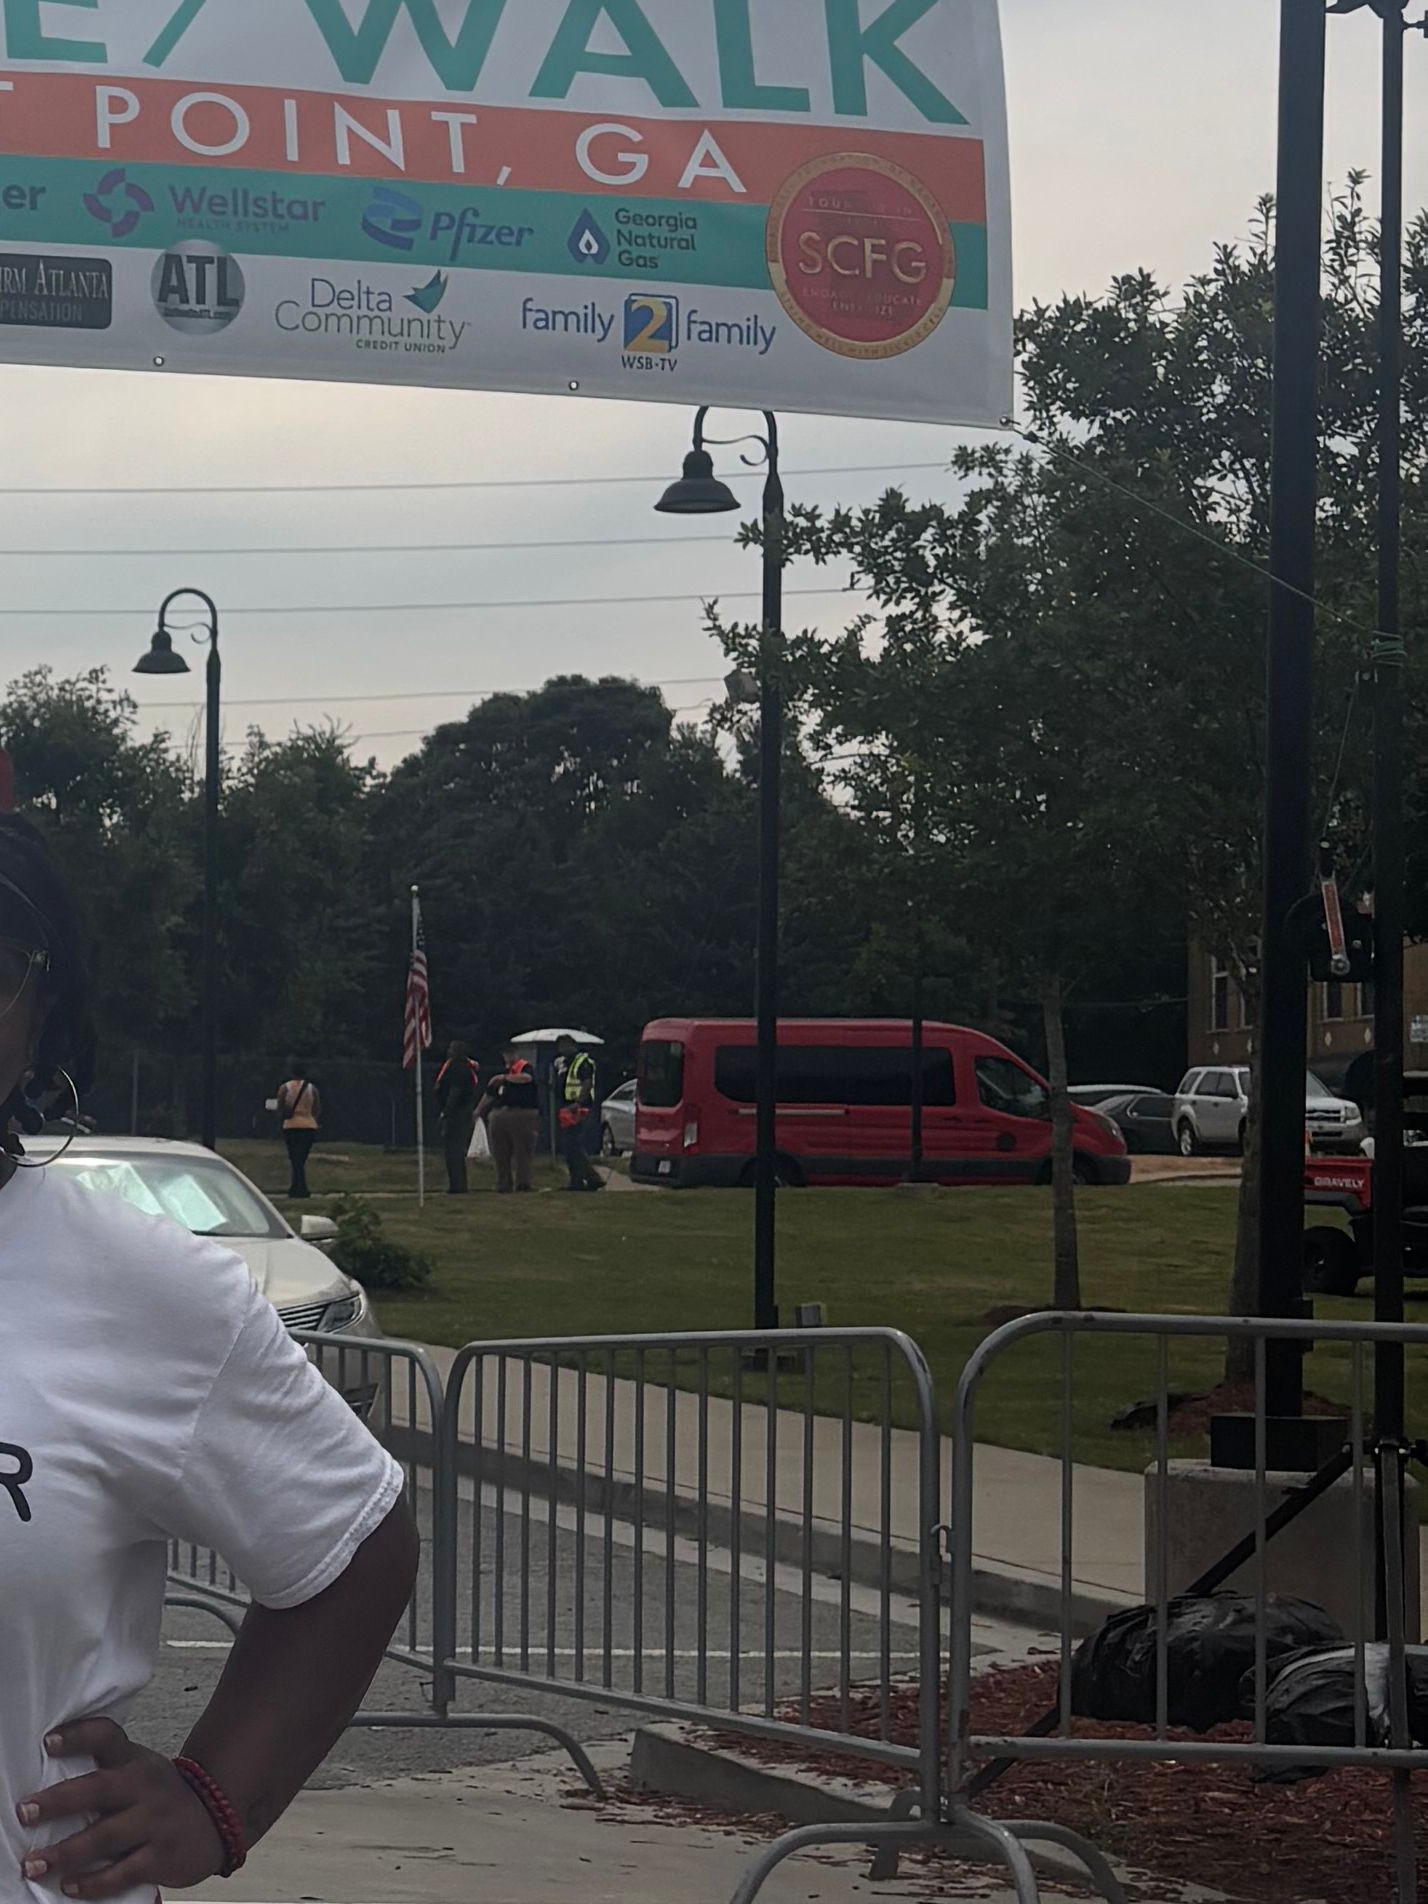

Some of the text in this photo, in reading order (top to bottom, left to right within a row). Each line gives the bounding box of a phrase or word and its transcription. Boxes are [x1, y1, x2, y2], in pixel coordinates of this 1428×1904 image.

[95, 84, 512, 188] POINT,
[574, 122, 748, 194] GA
[167, 184, 326, 223] Wellstar
[615, 207, 698, 234] Georgia
[236, 220, 290, 235] SYSTEM
[428, 207, 535, 262] Pfizer
[616, 230, 697, 253] Natural
[617, 251, 660, 270] Gas
[797, 230, 927, 284] SCFG
[34, 259, 111, 299] ATLANTA
[156, 252, 240, 308] ATL
[310, 277, 394, 313] Delta
[275, 300, 467, 350] Community
[521, 296, 615, 343] family
[686, 309, 777, 356] family
[355, 338, 447, 354] CREDIT UNION
